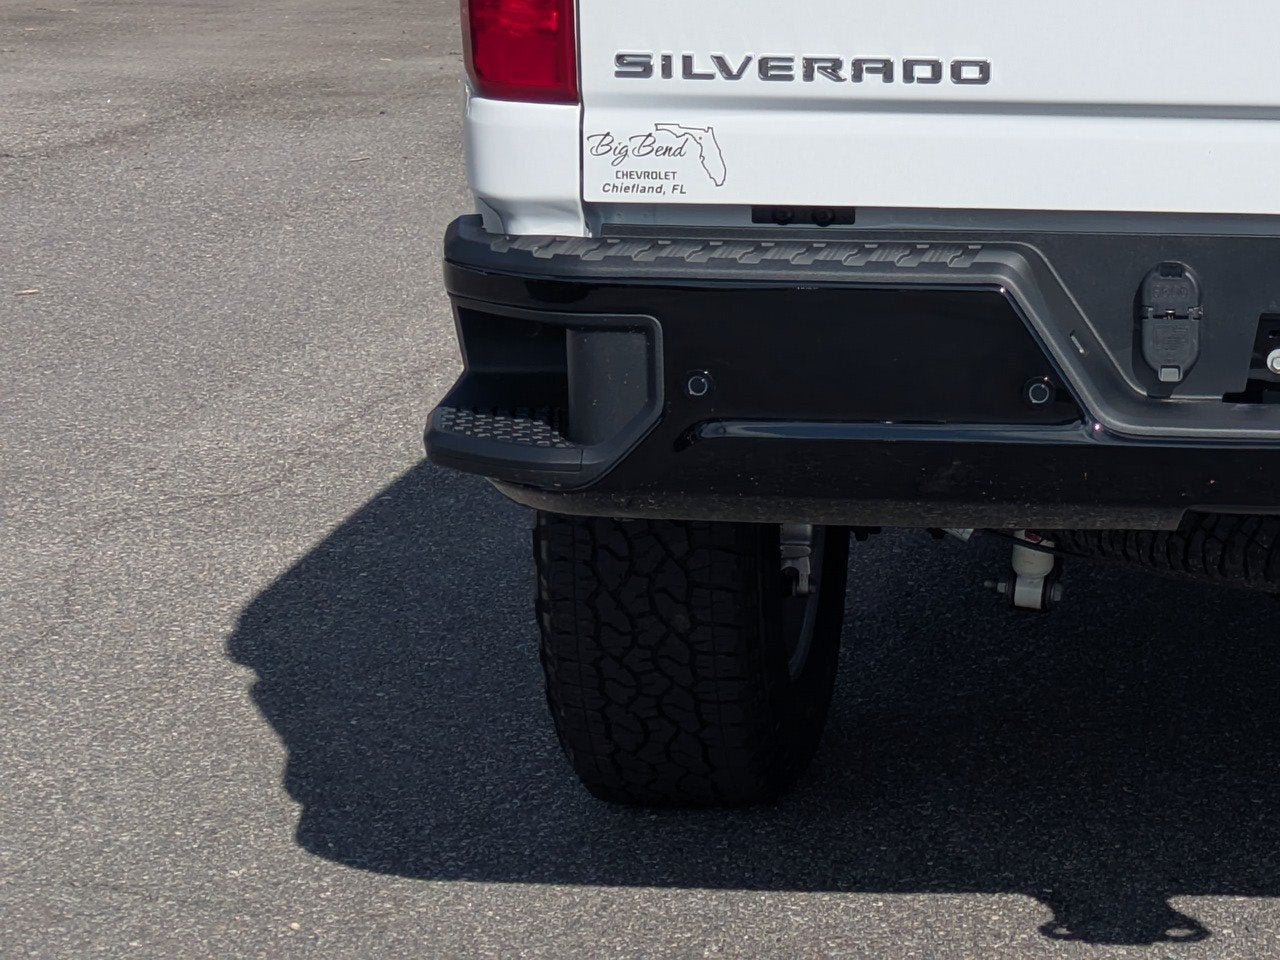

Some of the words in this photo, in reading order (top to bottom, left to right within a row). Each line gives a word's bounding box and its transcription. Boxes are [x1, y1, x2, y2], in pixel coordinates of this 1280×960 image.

[614, 51, 993, 85] SILVERADO
[586, 131, 630, 166] Big
[628, 132, 688, 157] Bend
[615, 170, 678, 181] CHEVROLET
[602, 182, 667, 196] Chiefland,
[671, 184, 687, 195] FL
